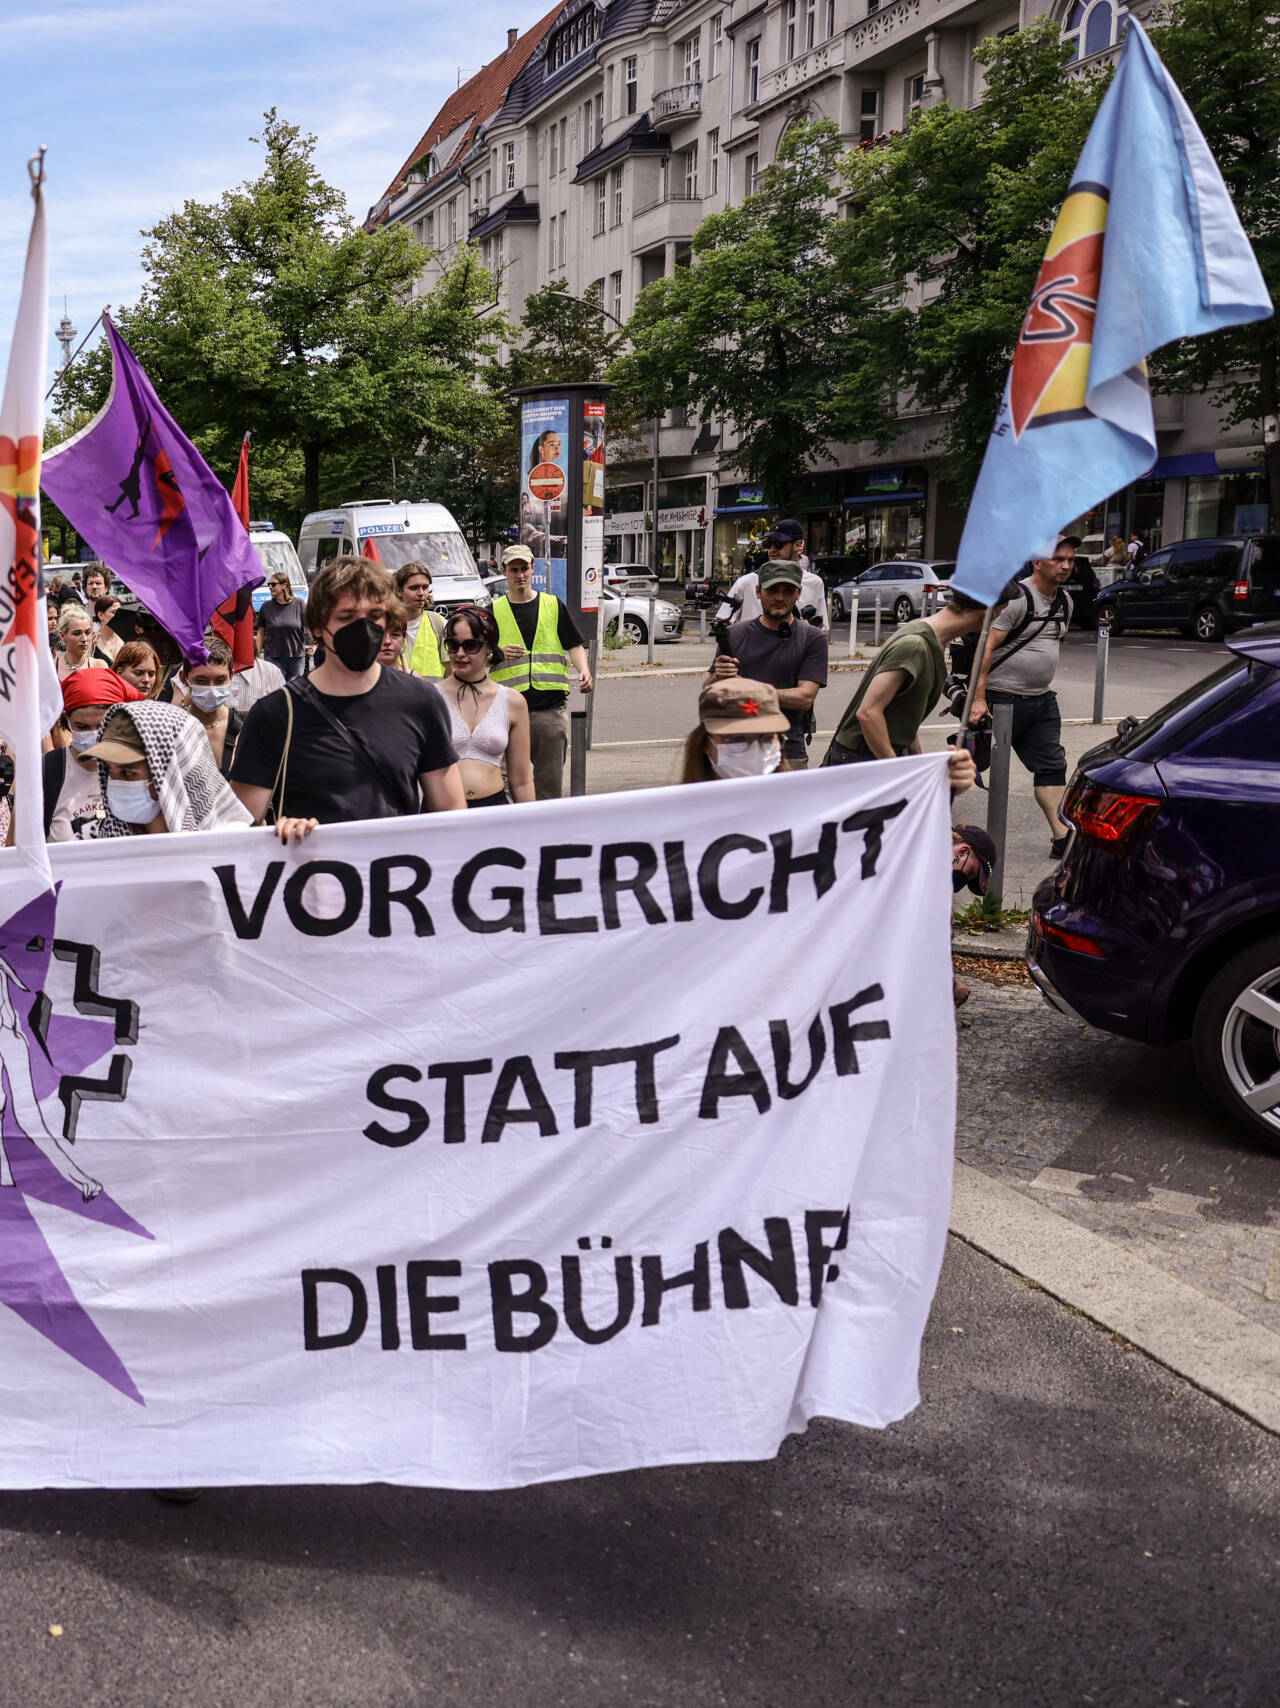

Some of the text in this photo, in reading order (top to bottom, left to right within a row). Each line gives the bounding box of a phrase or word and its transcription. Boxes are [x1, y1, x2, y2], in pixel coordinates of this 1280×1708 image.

[359, 525, 404, 536] POLIZEI
[213, 799, 909, 939] VOR GERICHT
[363, 984, 890, 1147] STATT AUF
[302, 1260, 466, 1350] DIE
